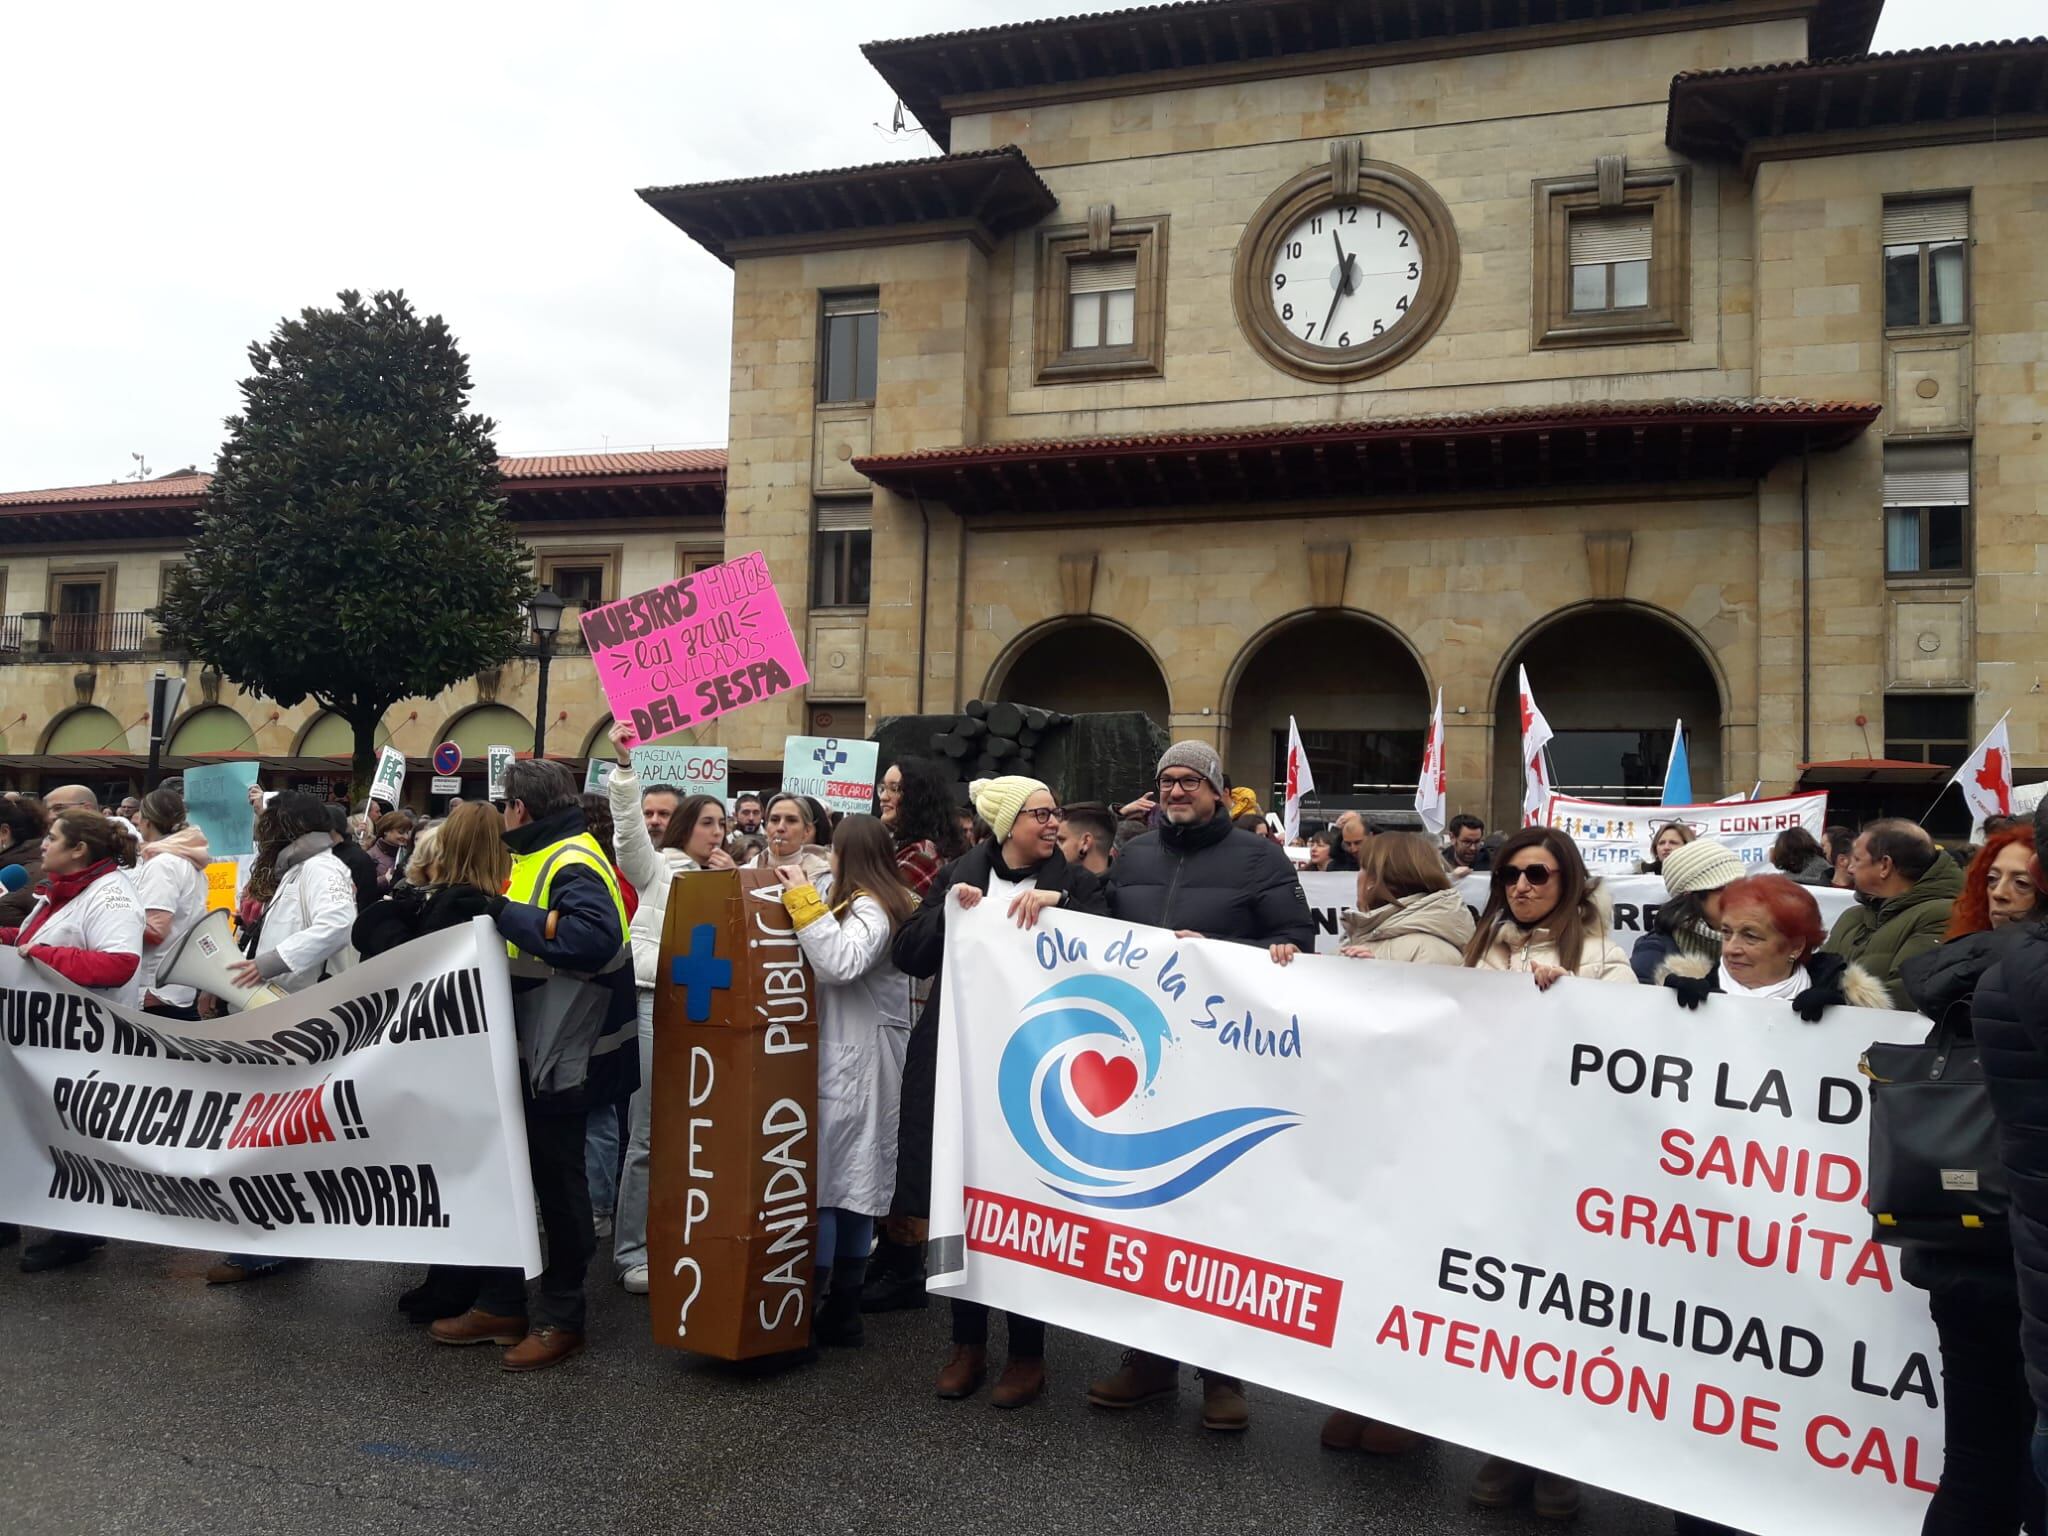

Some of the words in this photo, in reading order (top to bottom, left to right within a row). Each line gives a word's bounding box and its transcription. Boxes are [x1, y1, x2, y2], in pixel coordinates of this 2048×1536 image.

[1311, 217, 1323, 235] 11
[1338, 206, 1357, 225] 12
[1376, 210, 1382, 229] 1
[1286, 242, 1302, 260] 10
[1398, 229, 1409, 248] 2
[1274, 274, 1287, 290] 9
[1407, 262, 1419, 280] 3
[1282, 303, 1293, 321] 8
[1396, 295, 1408, 313] 4
[1304, 322, 1316, 341] 7
[1338, 331, 1350, 347] 6
[1373, 319, 1385, 338] 5
[582, 577, 698, 653] NUESTROS
[634, 637, 673, 670] los
[680, 610, 741, 657] gran
[650, 631, 766, 692] OLVIDADOS
[630, 693, 692, 742] DEL
[695, 657, 792, 717] SESPA
[826, 782, 873, 798] PRECARIO
[1719, 813, 1802, 833] CONTRA
[1035, 926, 1088, 971] Ola
[1103, 929, 1149, 970] de
[1156, 950, 1188, 1003] la
[1190, 994, 1303, 1060] Salud
[246, 1017, 341, 1066] POR
[329, 987, 400, 1057] UNA
[388, 967, 489, 1044] SANI
[1569, 1042, 1694, 1104] POR
[1713, 1061, 1793, 1119] LA
[1817, 1075, 1864, 1126] D
[53, 1069, 194, 1148] PÚBLICA
[185, 1090, 242, 1150] DE
[227, 1072, 336, 1151] CALIDÁ
[333, 1079, 371, 1140] !!
[48, 1144, 105, 1205] NON
[93, 1157, 240, 1225] DEIXEMOS
[228, 1172, 316, 1231] QUE
[303, 1163, 450, 1228] MORRA.
[1659, 1127, 1869, 1208] SANID
[1574, 1186, 1894, 1294] GRATUÍTA
[1103, 1232, 1148, 1283] ES
[1164, 1248, 1324, 1333] CUIDARTE
[1437, 1246, 1824, 1378] ESTABILIDAD
[1374, 1303, 1671, 1422] ATENCIÓN
[1692, 1382, 1782, 1453] DE
